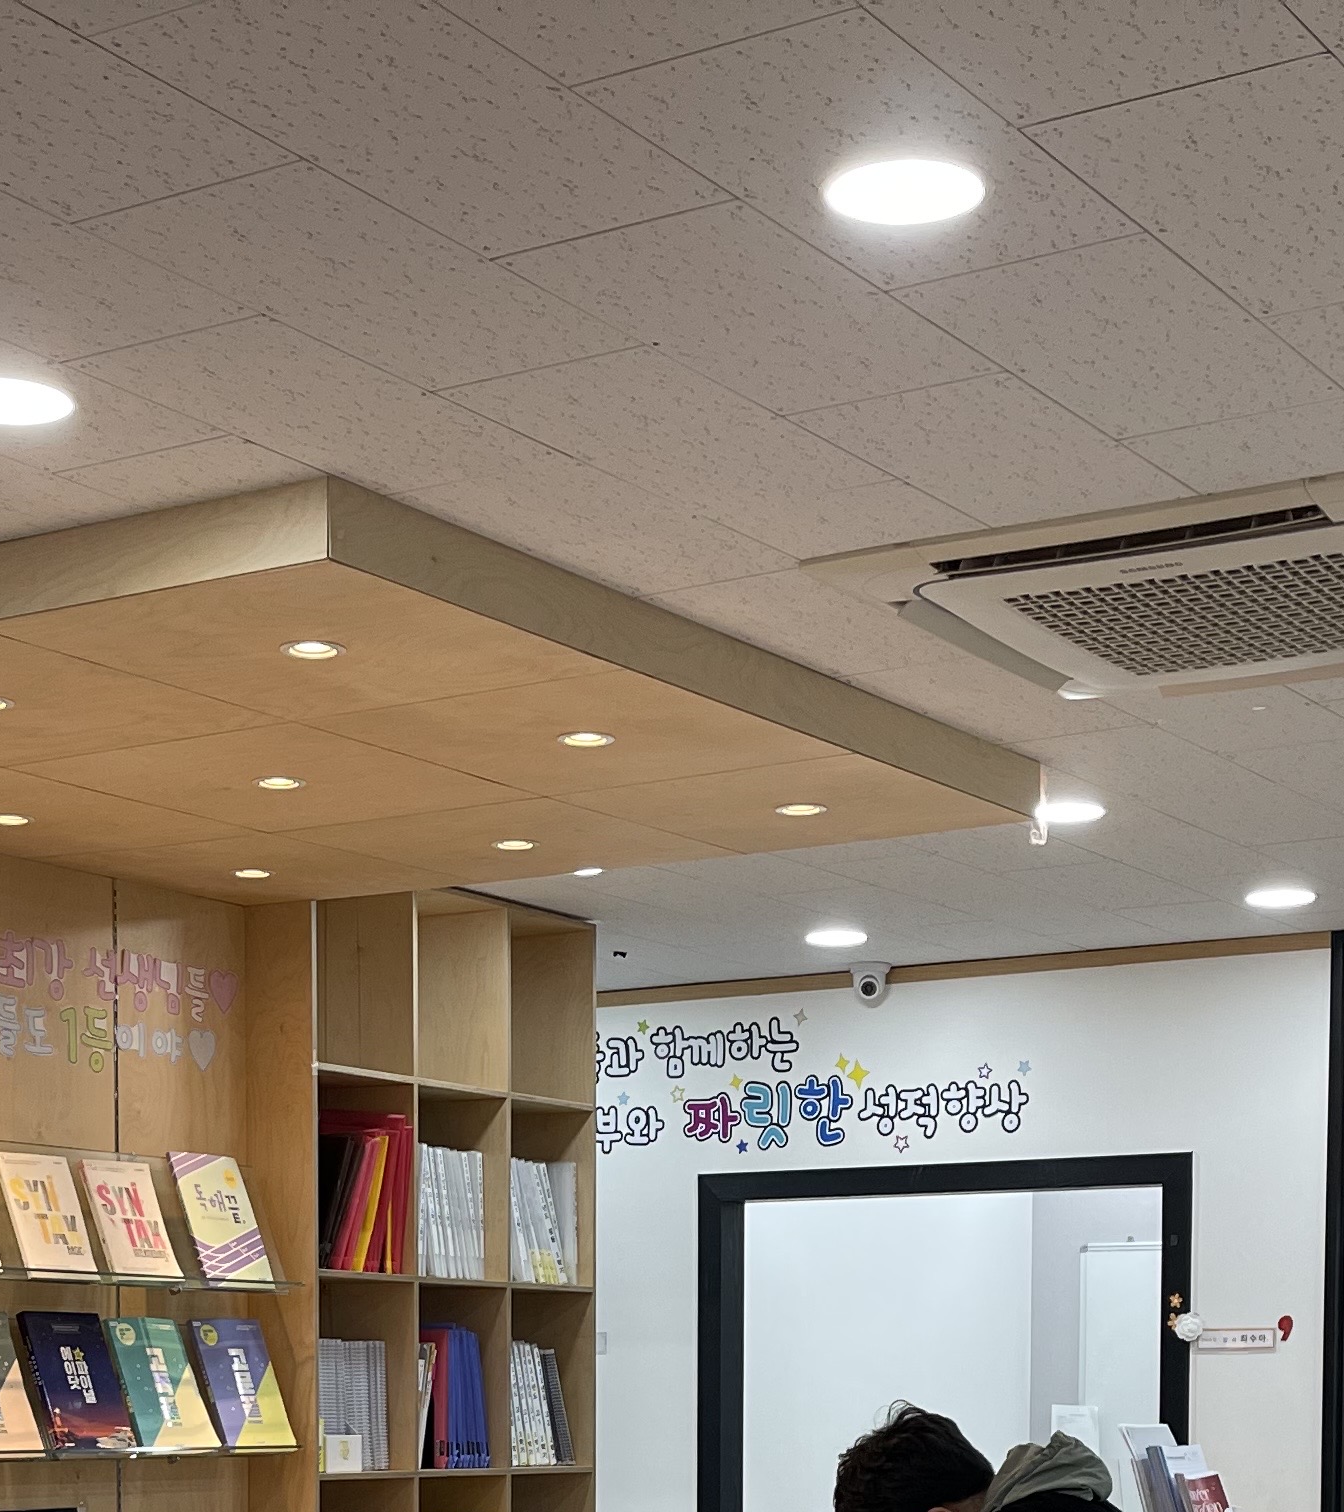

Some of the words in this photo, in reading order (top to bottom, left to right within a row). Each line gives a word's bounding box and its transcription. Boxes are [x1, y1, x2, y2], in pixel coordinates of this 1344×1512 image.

[650, 1017, 799, 1079] 함께하는
[683, 1074, 854, 1151] 짜릿한
[857, 1079, 1029, 1139] 성적향상
